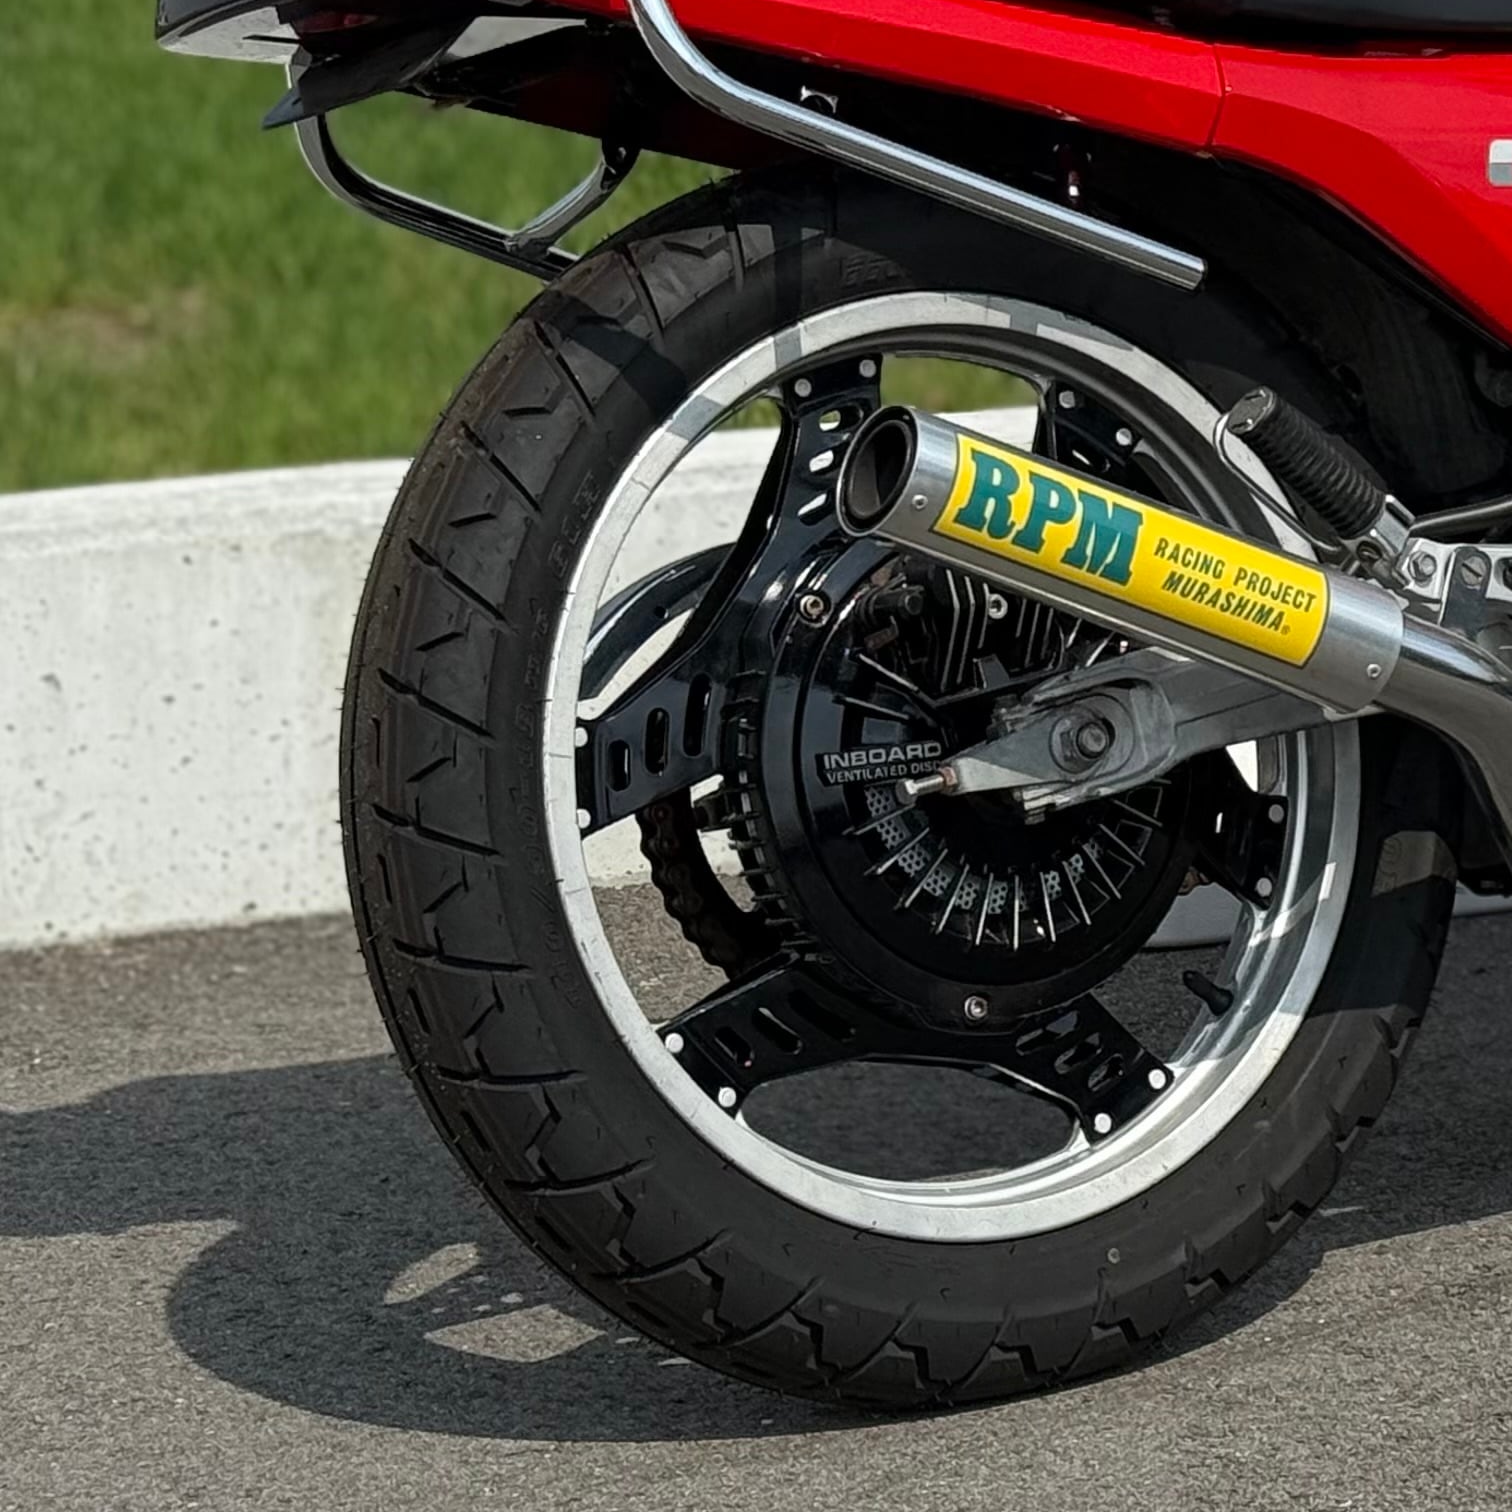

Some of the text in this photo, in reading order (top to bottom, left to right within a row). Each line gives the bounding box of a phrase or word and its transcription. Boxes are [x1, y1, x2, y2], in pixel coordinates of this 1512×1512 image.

[954, 448, 1143, 587] RPM
[1154, 537, 1318, 613] RACING PROJECT
[1161, 570, 1287, 633] MURASHIMA
[823, 742, 942, 770] INBOARD
[826, 763, 907, 784] VENTILATED
